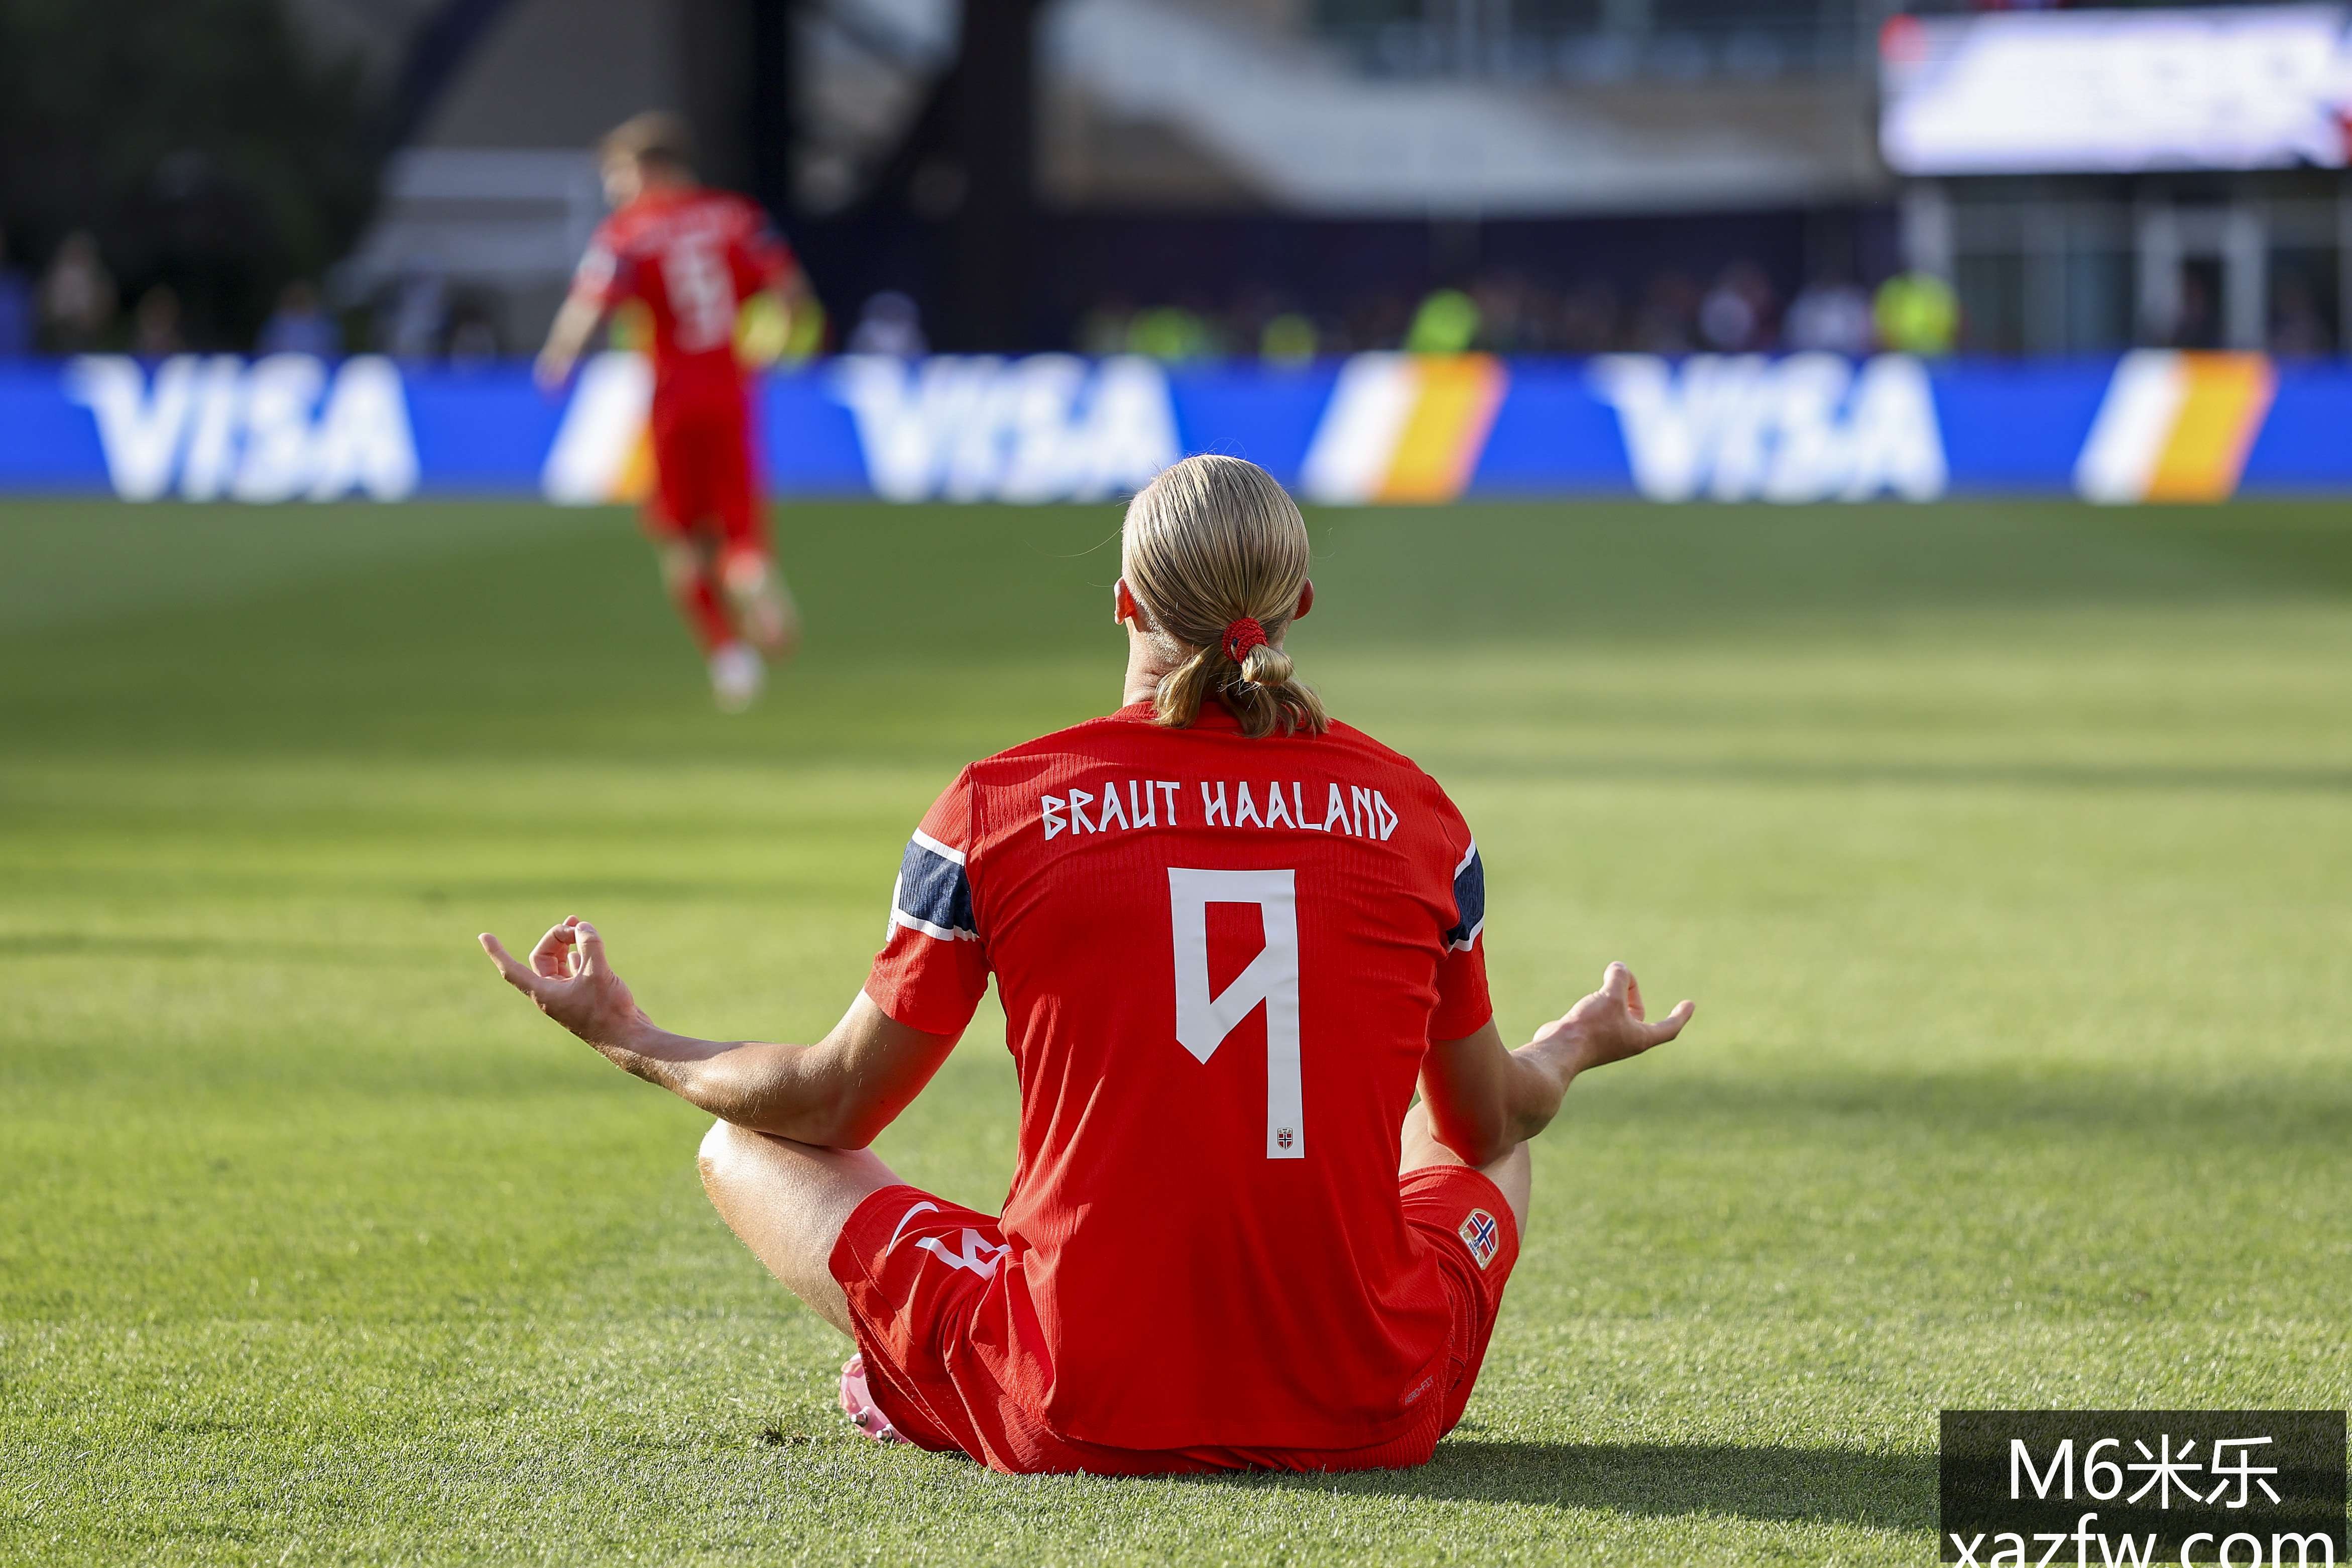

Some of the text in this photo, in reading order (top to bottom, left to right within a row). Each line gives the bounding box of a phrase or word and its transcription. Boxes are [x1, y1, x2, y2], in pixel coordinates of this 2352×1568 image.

[68, 354, 418, 501] VISA
[835, 353, 1178, 501] VISA
[1591, 353, 1947, 501] VISA
[1041, 780, 1399, 841] BRAUT HAALAND
[1167, 867, 1305, 1159] 9
